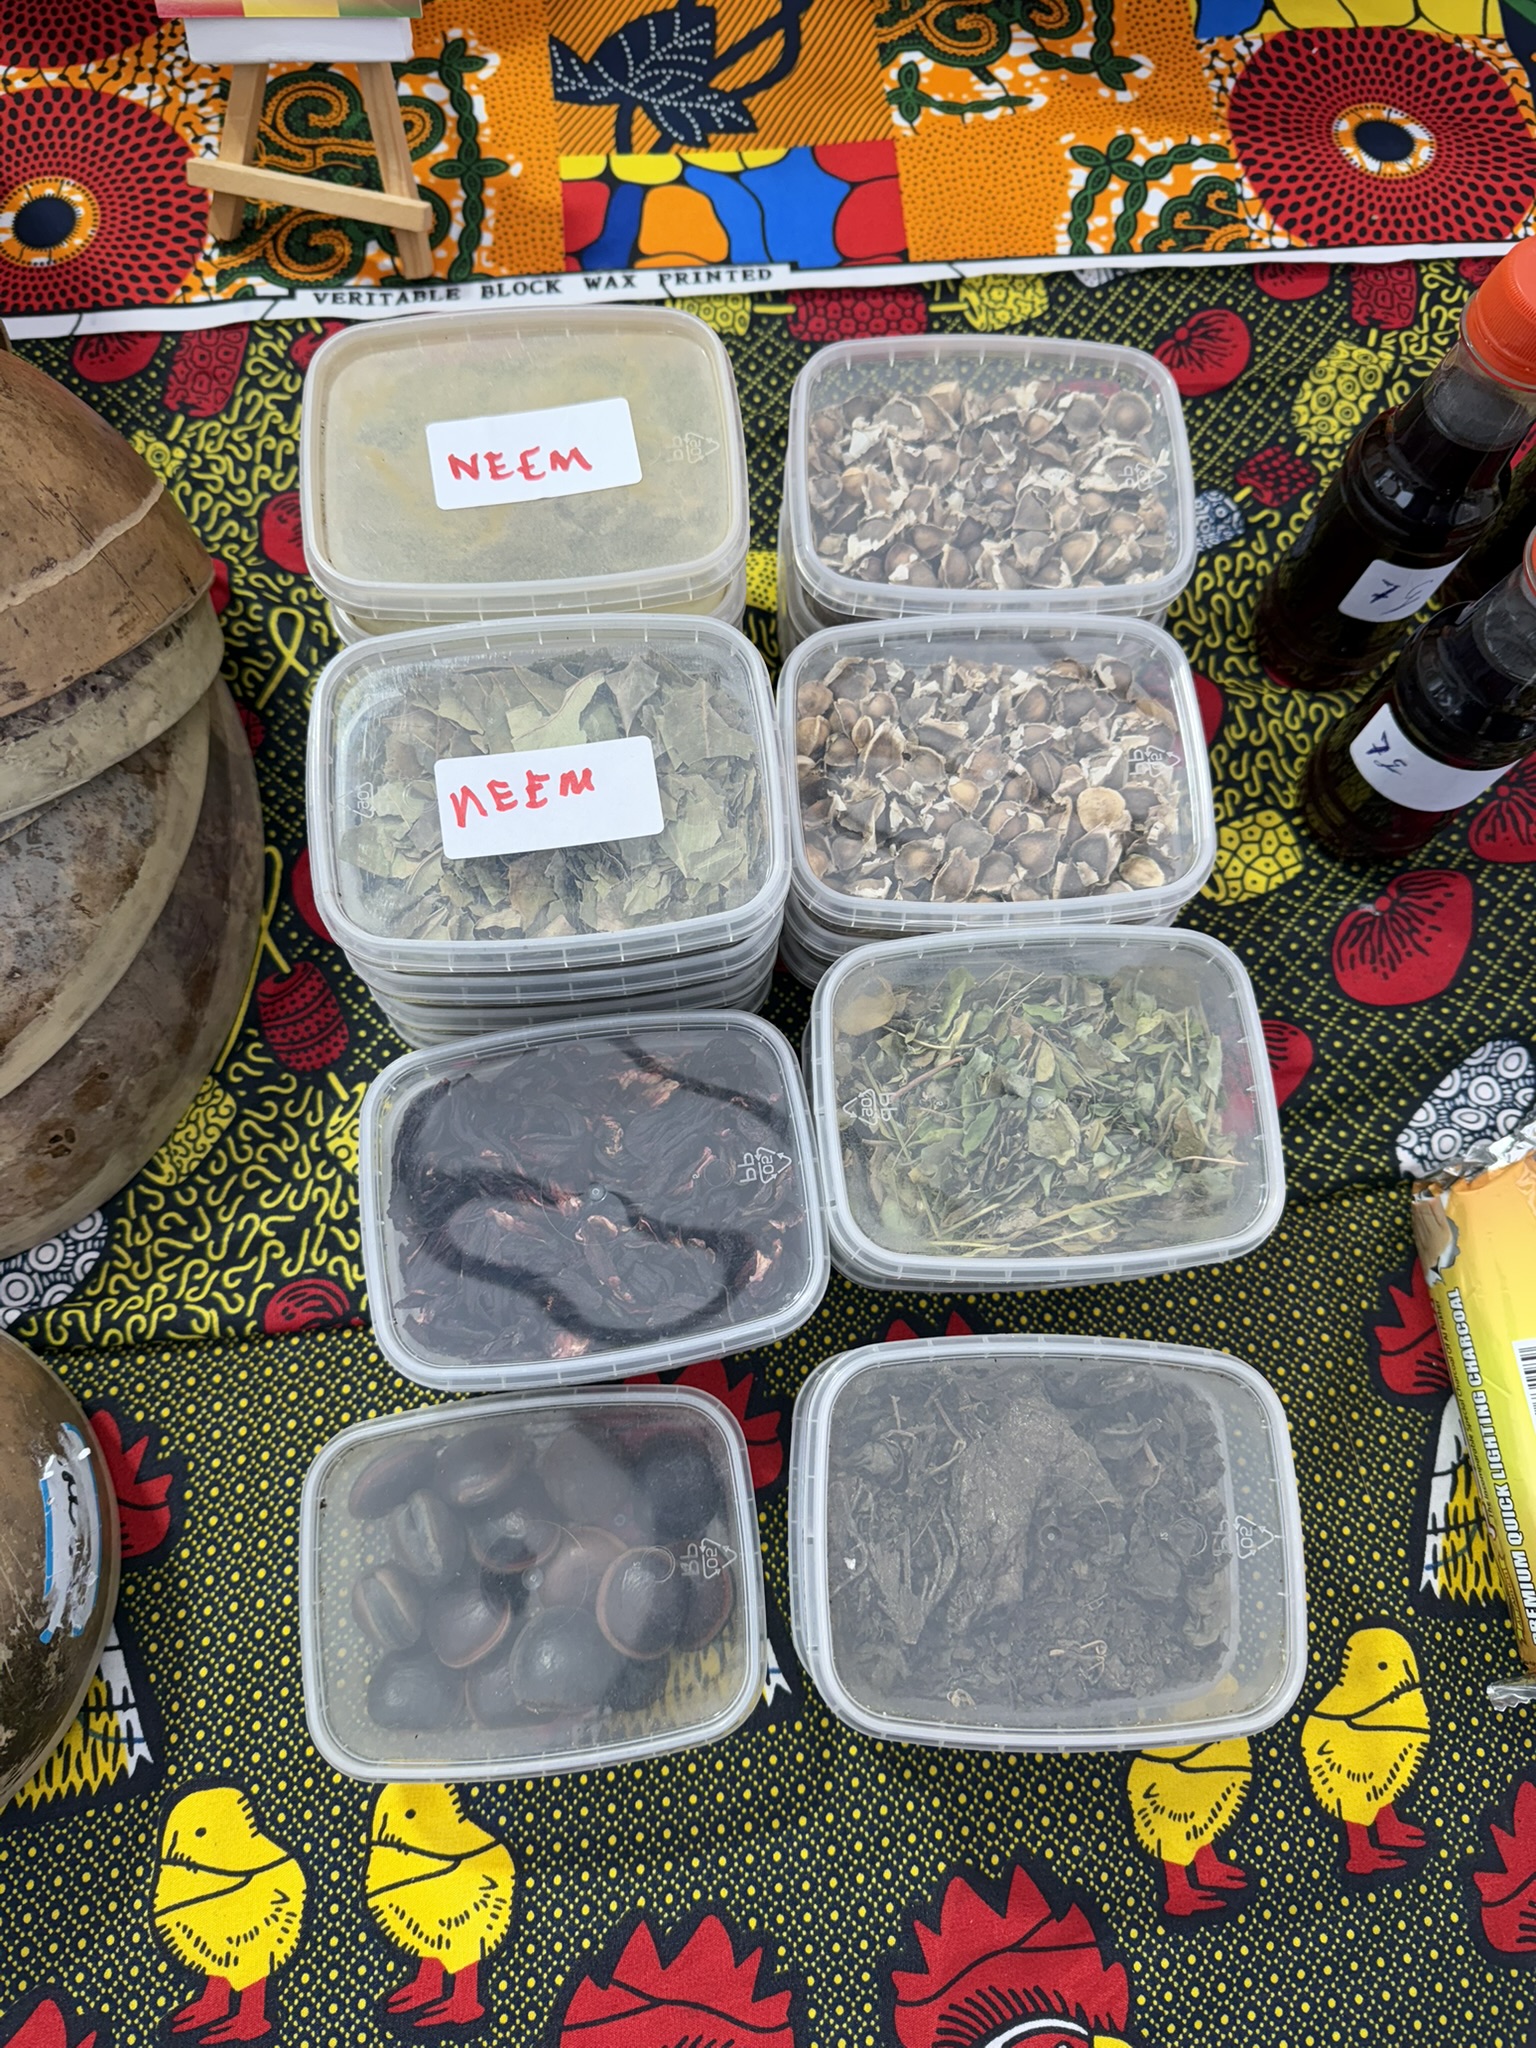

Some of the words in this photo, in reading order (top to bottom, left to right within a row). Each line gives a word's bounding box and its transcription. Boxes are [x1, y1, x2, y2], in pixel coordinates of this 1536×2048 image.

[313, 286, 461, 307] VERITABLE
[481, 278, 562, 299] BLOCK
[584, 274, 637, 291] WAX
[658, 268, 772, 287] PRINTED
[447, 446, 593, 481] NEEM
[449, 767, 595, 829] NEEM
[1447, 1286, 1483, 1388] CHARCOAL
[1471, 1389, 1507, 1481] LIGHTING
[1494, 1482, 1525, 1546] QUICK
[1511, 1549, 1536, 1646] EMIUM
